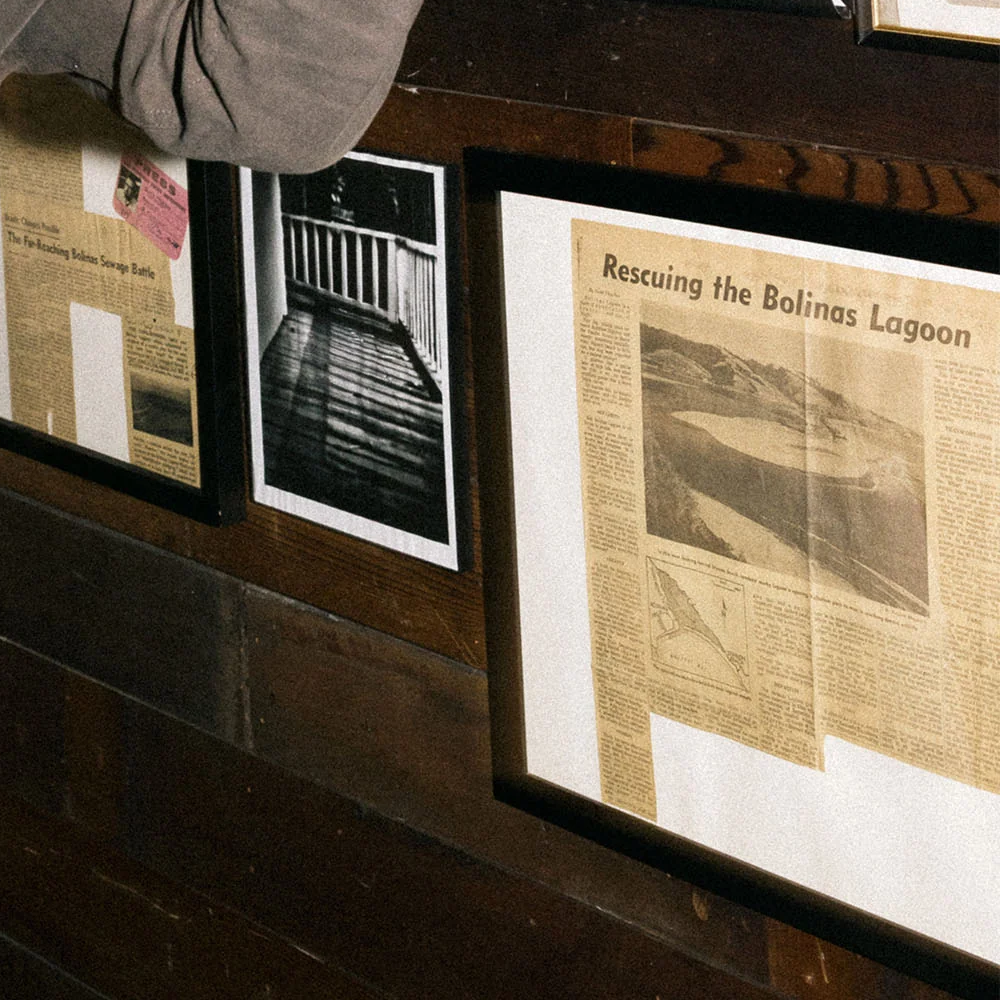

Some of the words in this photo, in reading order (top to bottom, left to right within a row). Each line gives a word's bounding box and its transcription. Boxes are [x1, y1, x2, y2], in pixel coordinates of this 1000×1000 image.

[7, 230, 22, 245] The
[100, 255, 130, 275] Sewage
[131, 262, 156, 280] Battle
[602, 252, 703, 301] Rescuing
[713, 275, 752, 307] the
[762, 283, 858, 328] Bolinas
[869, 303, 972, 349] Lagoon
